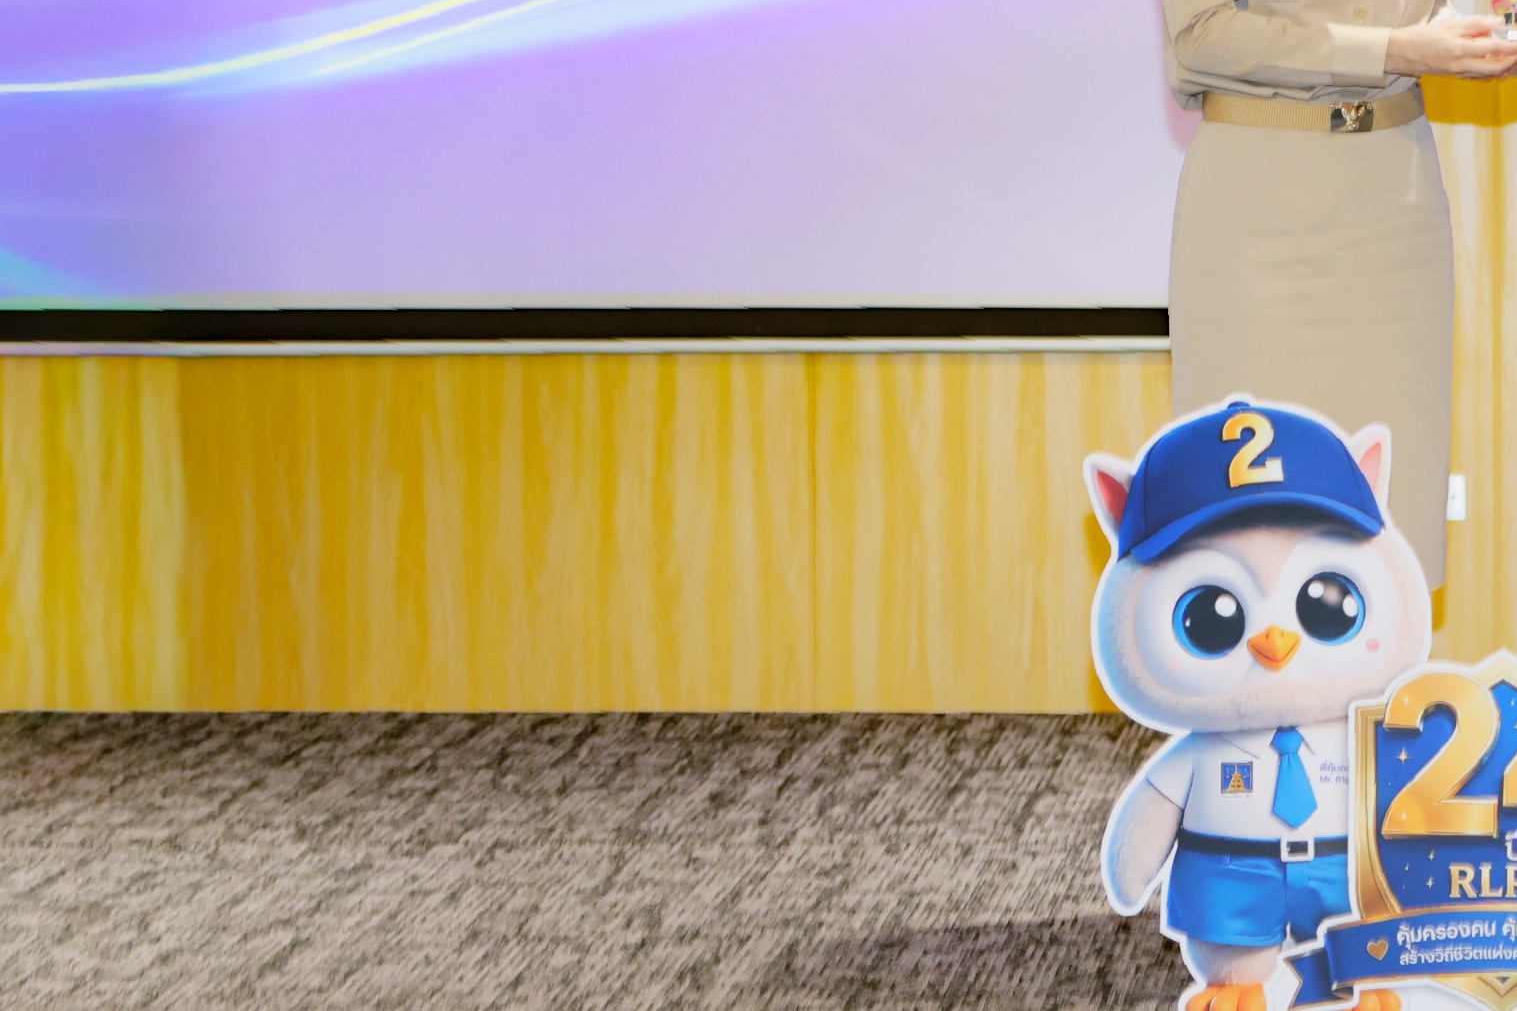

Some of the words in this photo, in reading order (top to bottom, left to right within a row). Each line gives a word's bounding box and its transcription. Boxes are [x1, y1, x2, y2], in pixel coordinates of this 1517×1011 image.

[1221, 413, 1285, 488] 2
[1320, 775, 1333, 784] Mr.
[1396, 922, 1497, 949] คุ้มครองคน
